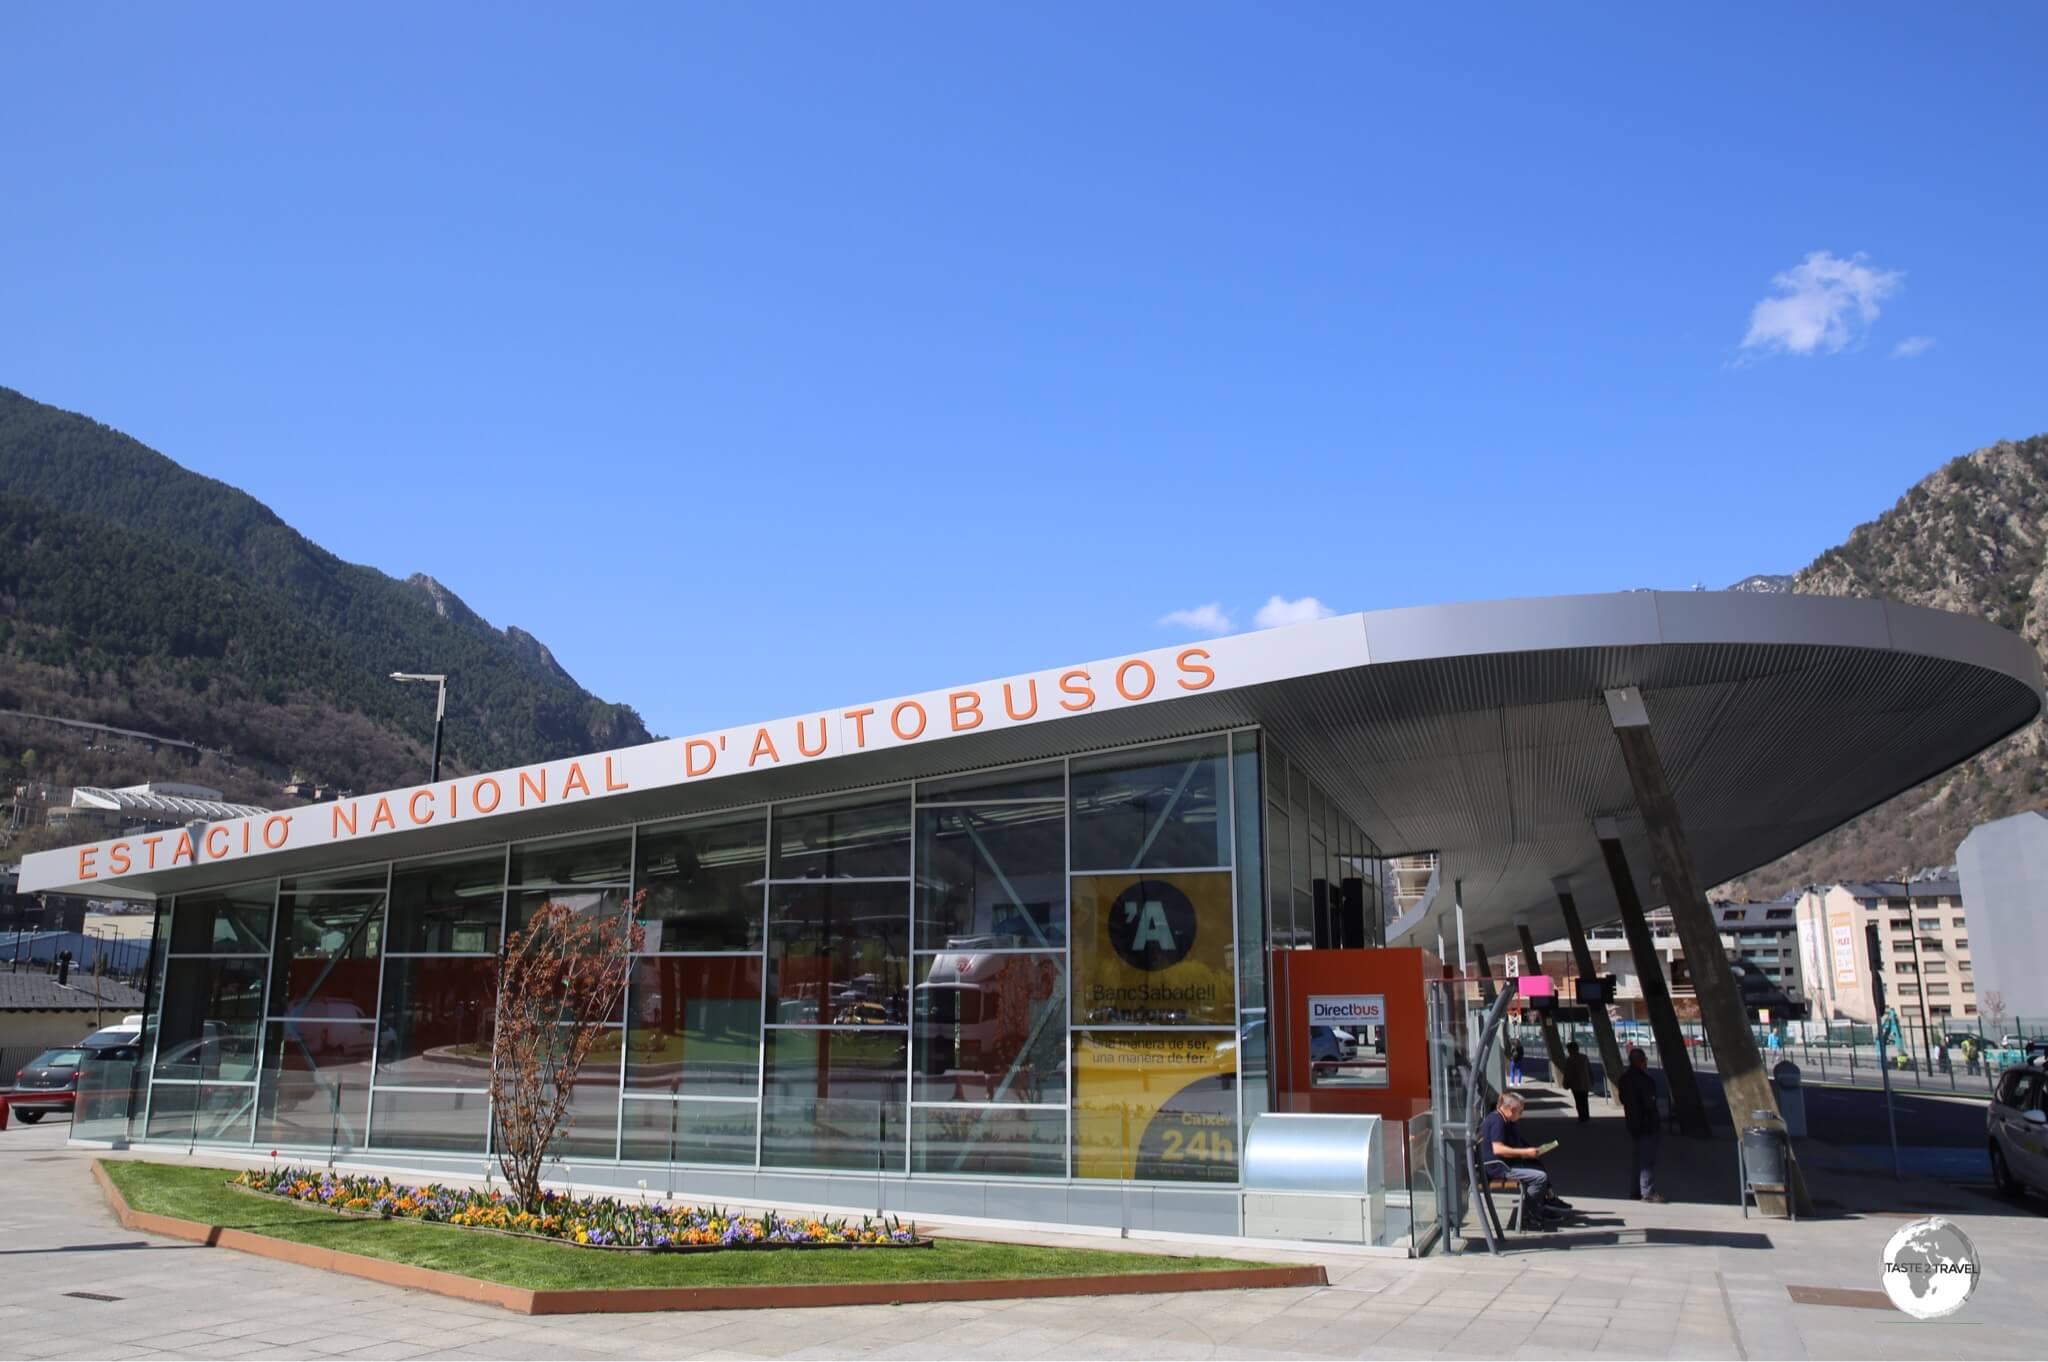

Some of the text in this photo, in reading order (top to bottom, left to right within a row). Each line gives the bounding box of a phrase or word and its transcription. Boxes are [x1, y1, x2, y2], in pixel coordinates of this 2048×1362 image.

[332, 756, 629, 838] NACIONAL
[684, 648, 1216, 777] D'AUTOBUSOS
[1093, 983, 1216, 1001] BancSabadell
[1314, 1003, 1379, 1016] Directbus
[1118, 1039, 1165, 1049] manera
[1168, 1037, 1184, 1049] de
[1092, 1054, 1115, 1064] una
[1118, 1054, 1164, 1064] manera
[1167, 1052, 1184, 1064] de
[1161, 1129, 1233, 1162] 24h
